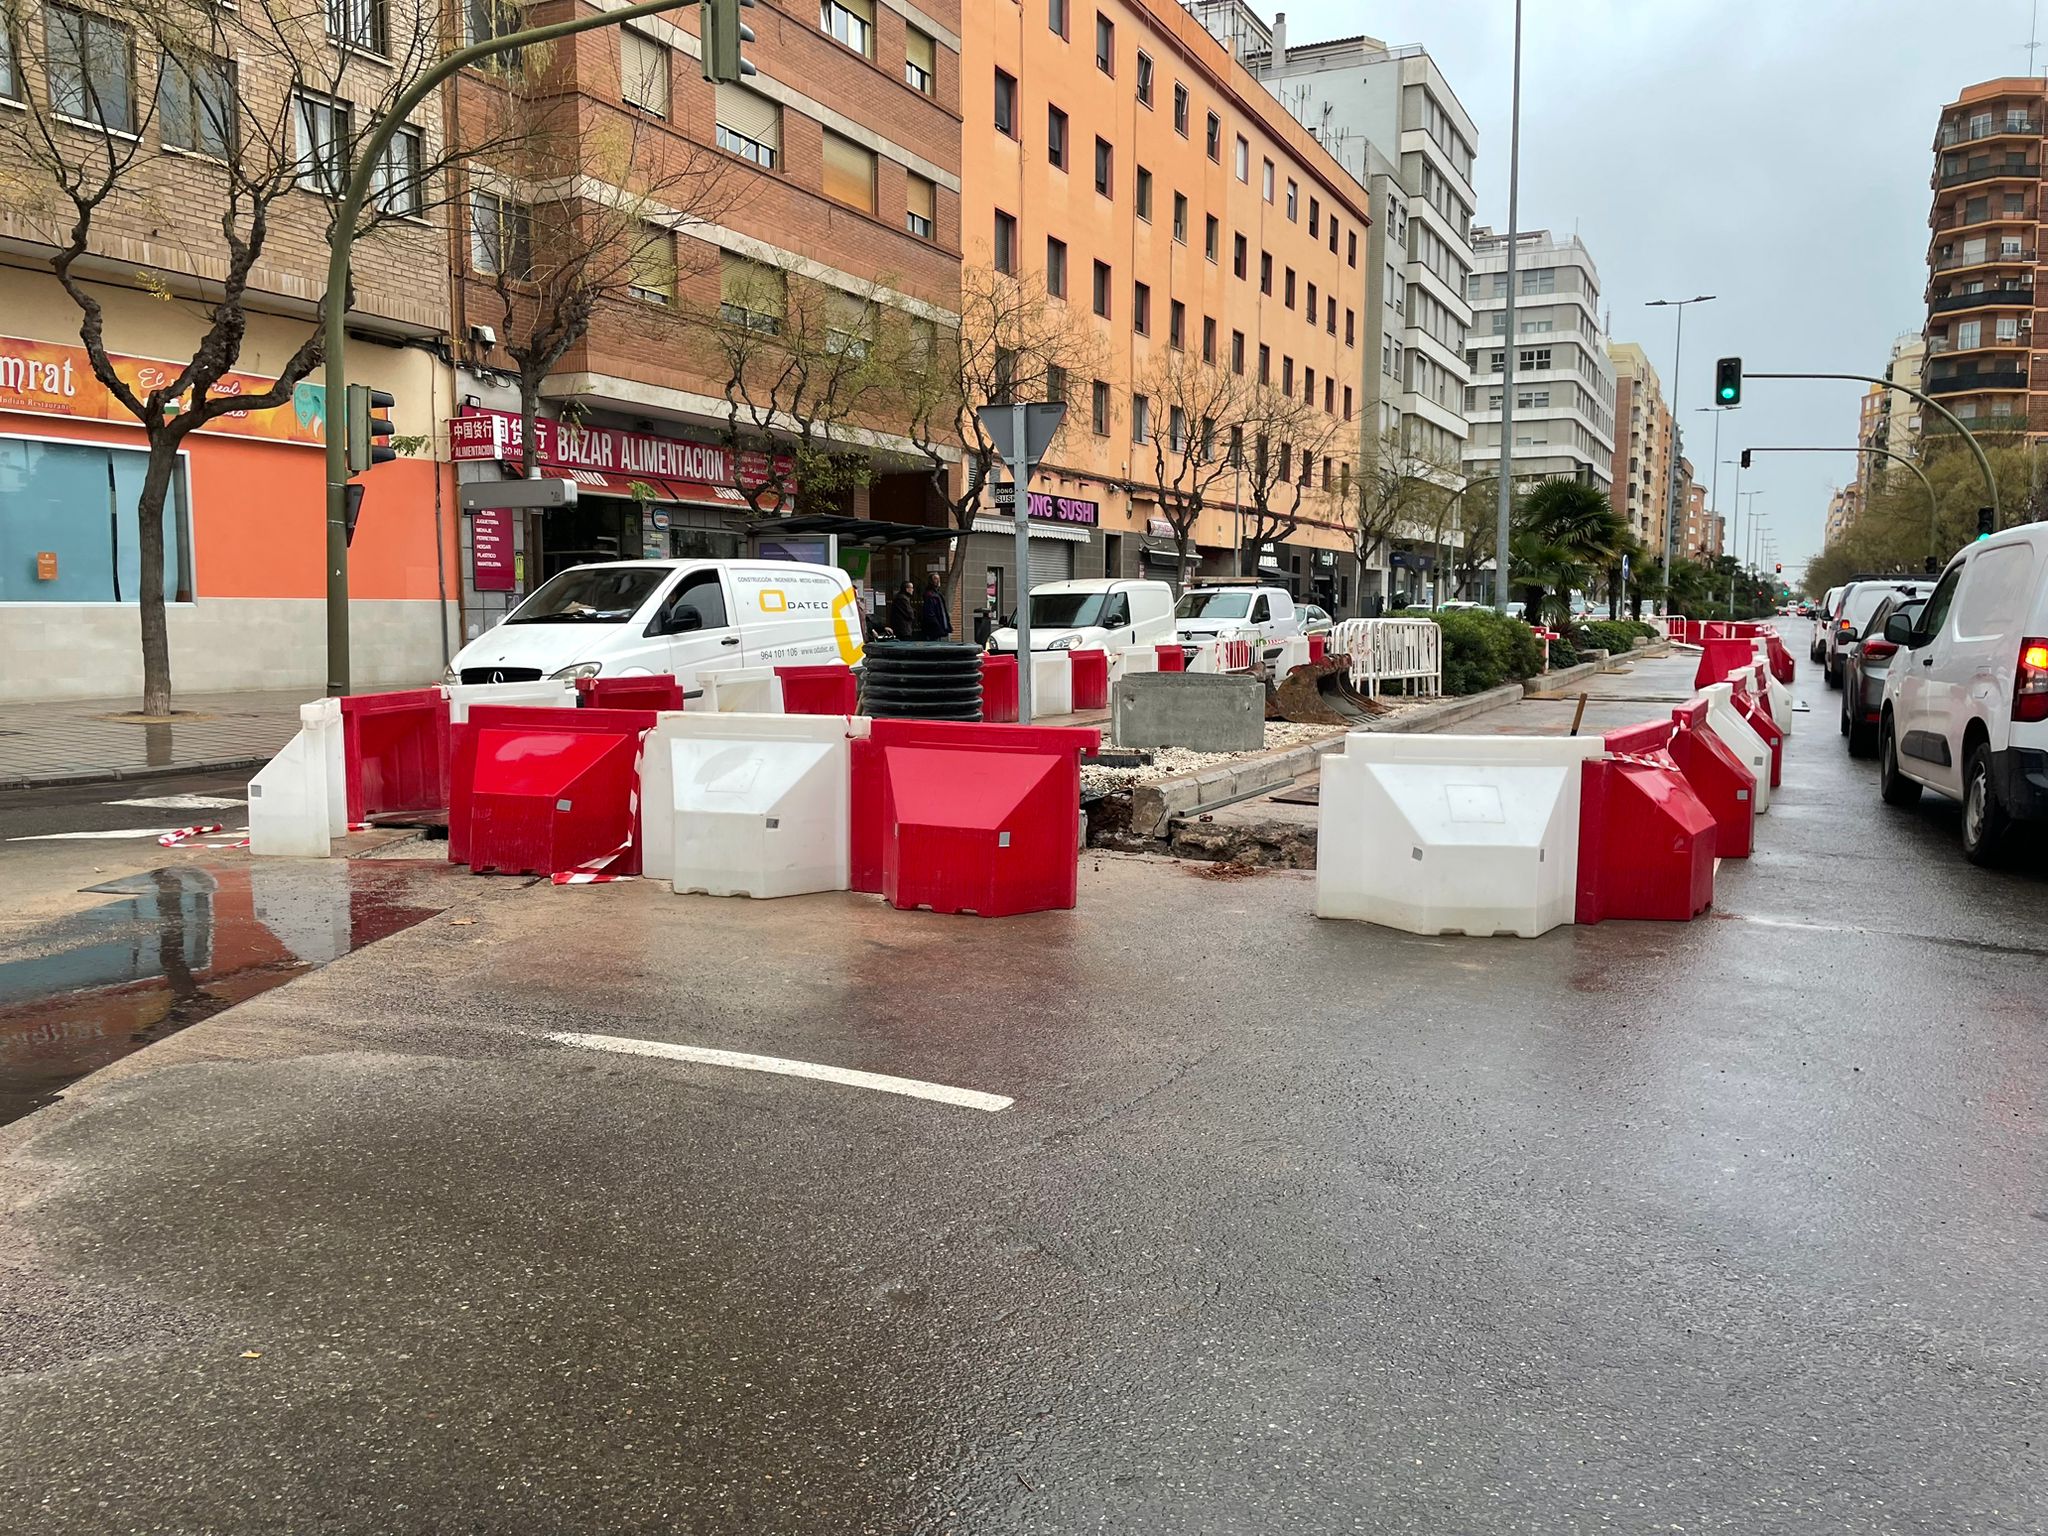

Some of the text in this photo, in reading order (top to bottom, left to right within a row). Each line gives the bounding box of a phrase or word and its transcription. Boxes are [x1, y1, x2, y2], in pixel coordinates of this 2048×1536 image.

[453, 421, 492, 440] 中国货行
[455, 445, 494, 457] ALIMENTACION
[556, 426, 724, 481] BAZAR ALIMENTACION
[568, 469, 609, 487] JUNO
[1027, 493, 1095, 523] ONG SUSHI
[760, 651, 773, 660] 964
[774, 649, 785, 658] 101
[787, 647, 798, 657] 106
